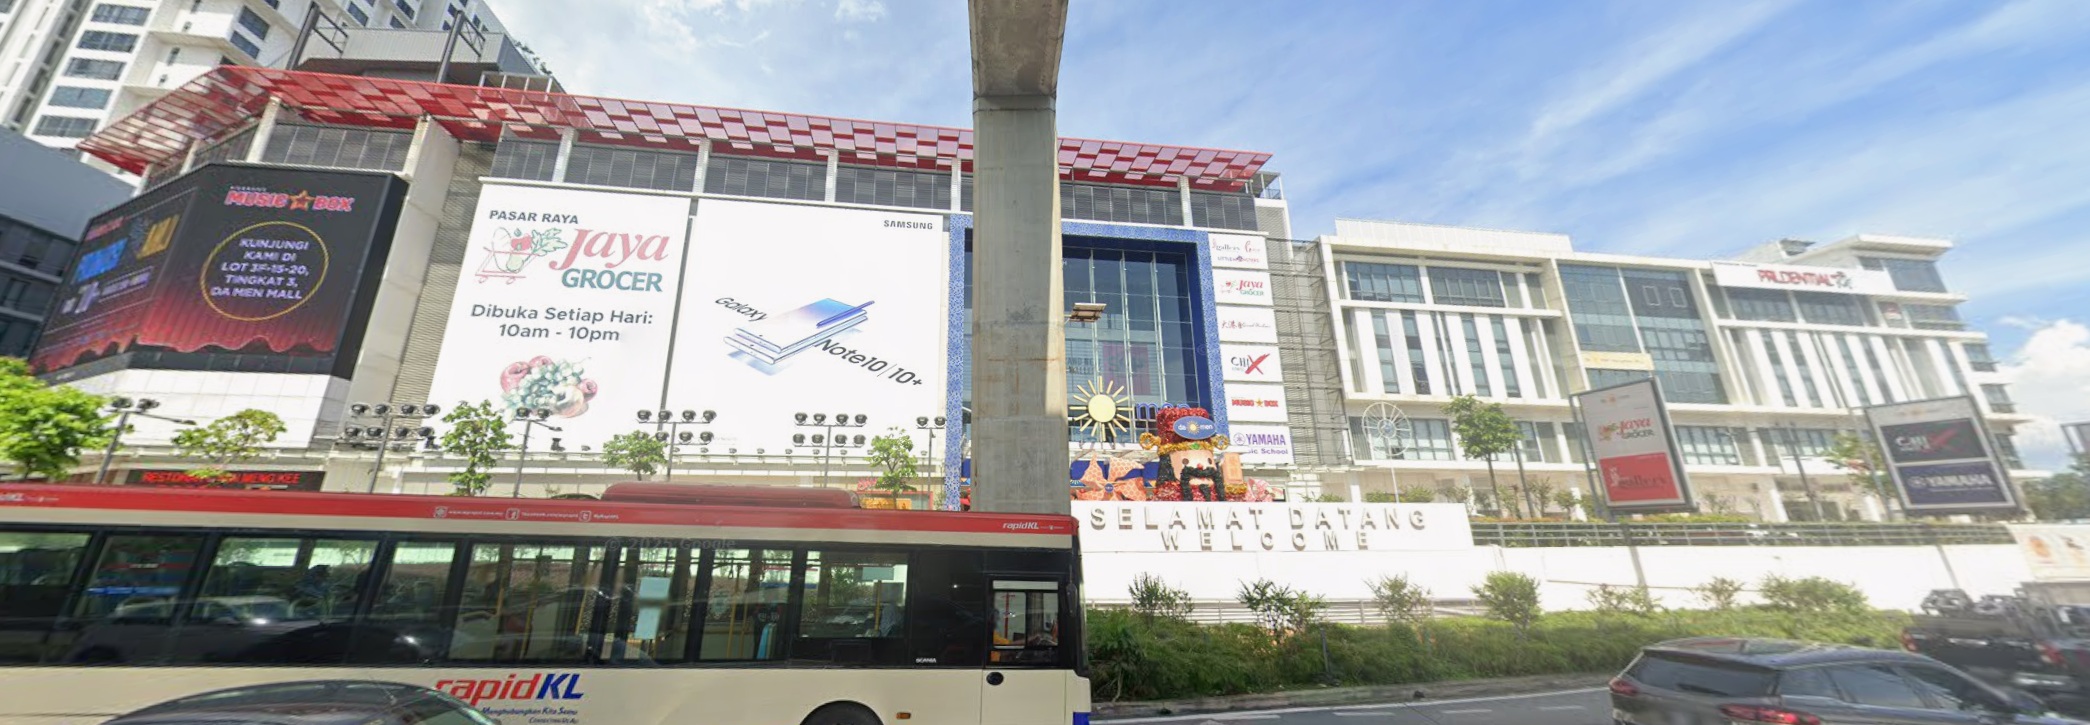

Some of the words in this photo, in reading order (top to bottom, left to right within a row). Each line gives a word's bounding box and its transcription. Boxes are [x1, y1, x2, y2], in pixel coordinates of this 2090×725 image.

[225, 190, 289, 208] MUSIC
[312, 196, 355, 212] BOX
[489, 210, 538, 222] PASAR
[542, 213, 579, 225] RAYA
[883, 219, 933, 230] SAMSUNG
[239, 238, 309, 250] KUNJUNGI
[548, 228, 670, 271] Jaya
[243, 250, 279, 261] KAMI
[281, 252, 296, 263] DI
[221, 262, 248, 272] LOT
[225, 274, 283, 286] TINGKAT
[286, 276, 299, 287] 3,
[561, 268, 663, 292] GROCER
[1757, 269, 1835, 287] PRUDENTIAL
[210, 286, 230, 297] DA
[232, 287, 264, 298] MEN
[266, 288, 303, 300] MALL
[470, 304, 539, 320] Dibuka
[544, 307, 604, 324] Setiap
[610, 310, 654, 325] Hari:
[714, 296, 768, 323] Galaxy
[499, 323, 550, 339] 10am
[568, 326, 621, 343] 10pm
[1246, 433, 1287, 446] YAMAHA
[1925, 474, 1995, 488] YAMAHA
[1090, 505, 1265, 530] SELAMAT
[1288, 506, 1428, 531] DATANG
[1003, 522, 1040, 531] rapidKL
[1160, 529, 1373, 552] WELCOME
[435, 673, 584, 706] rapidKL
